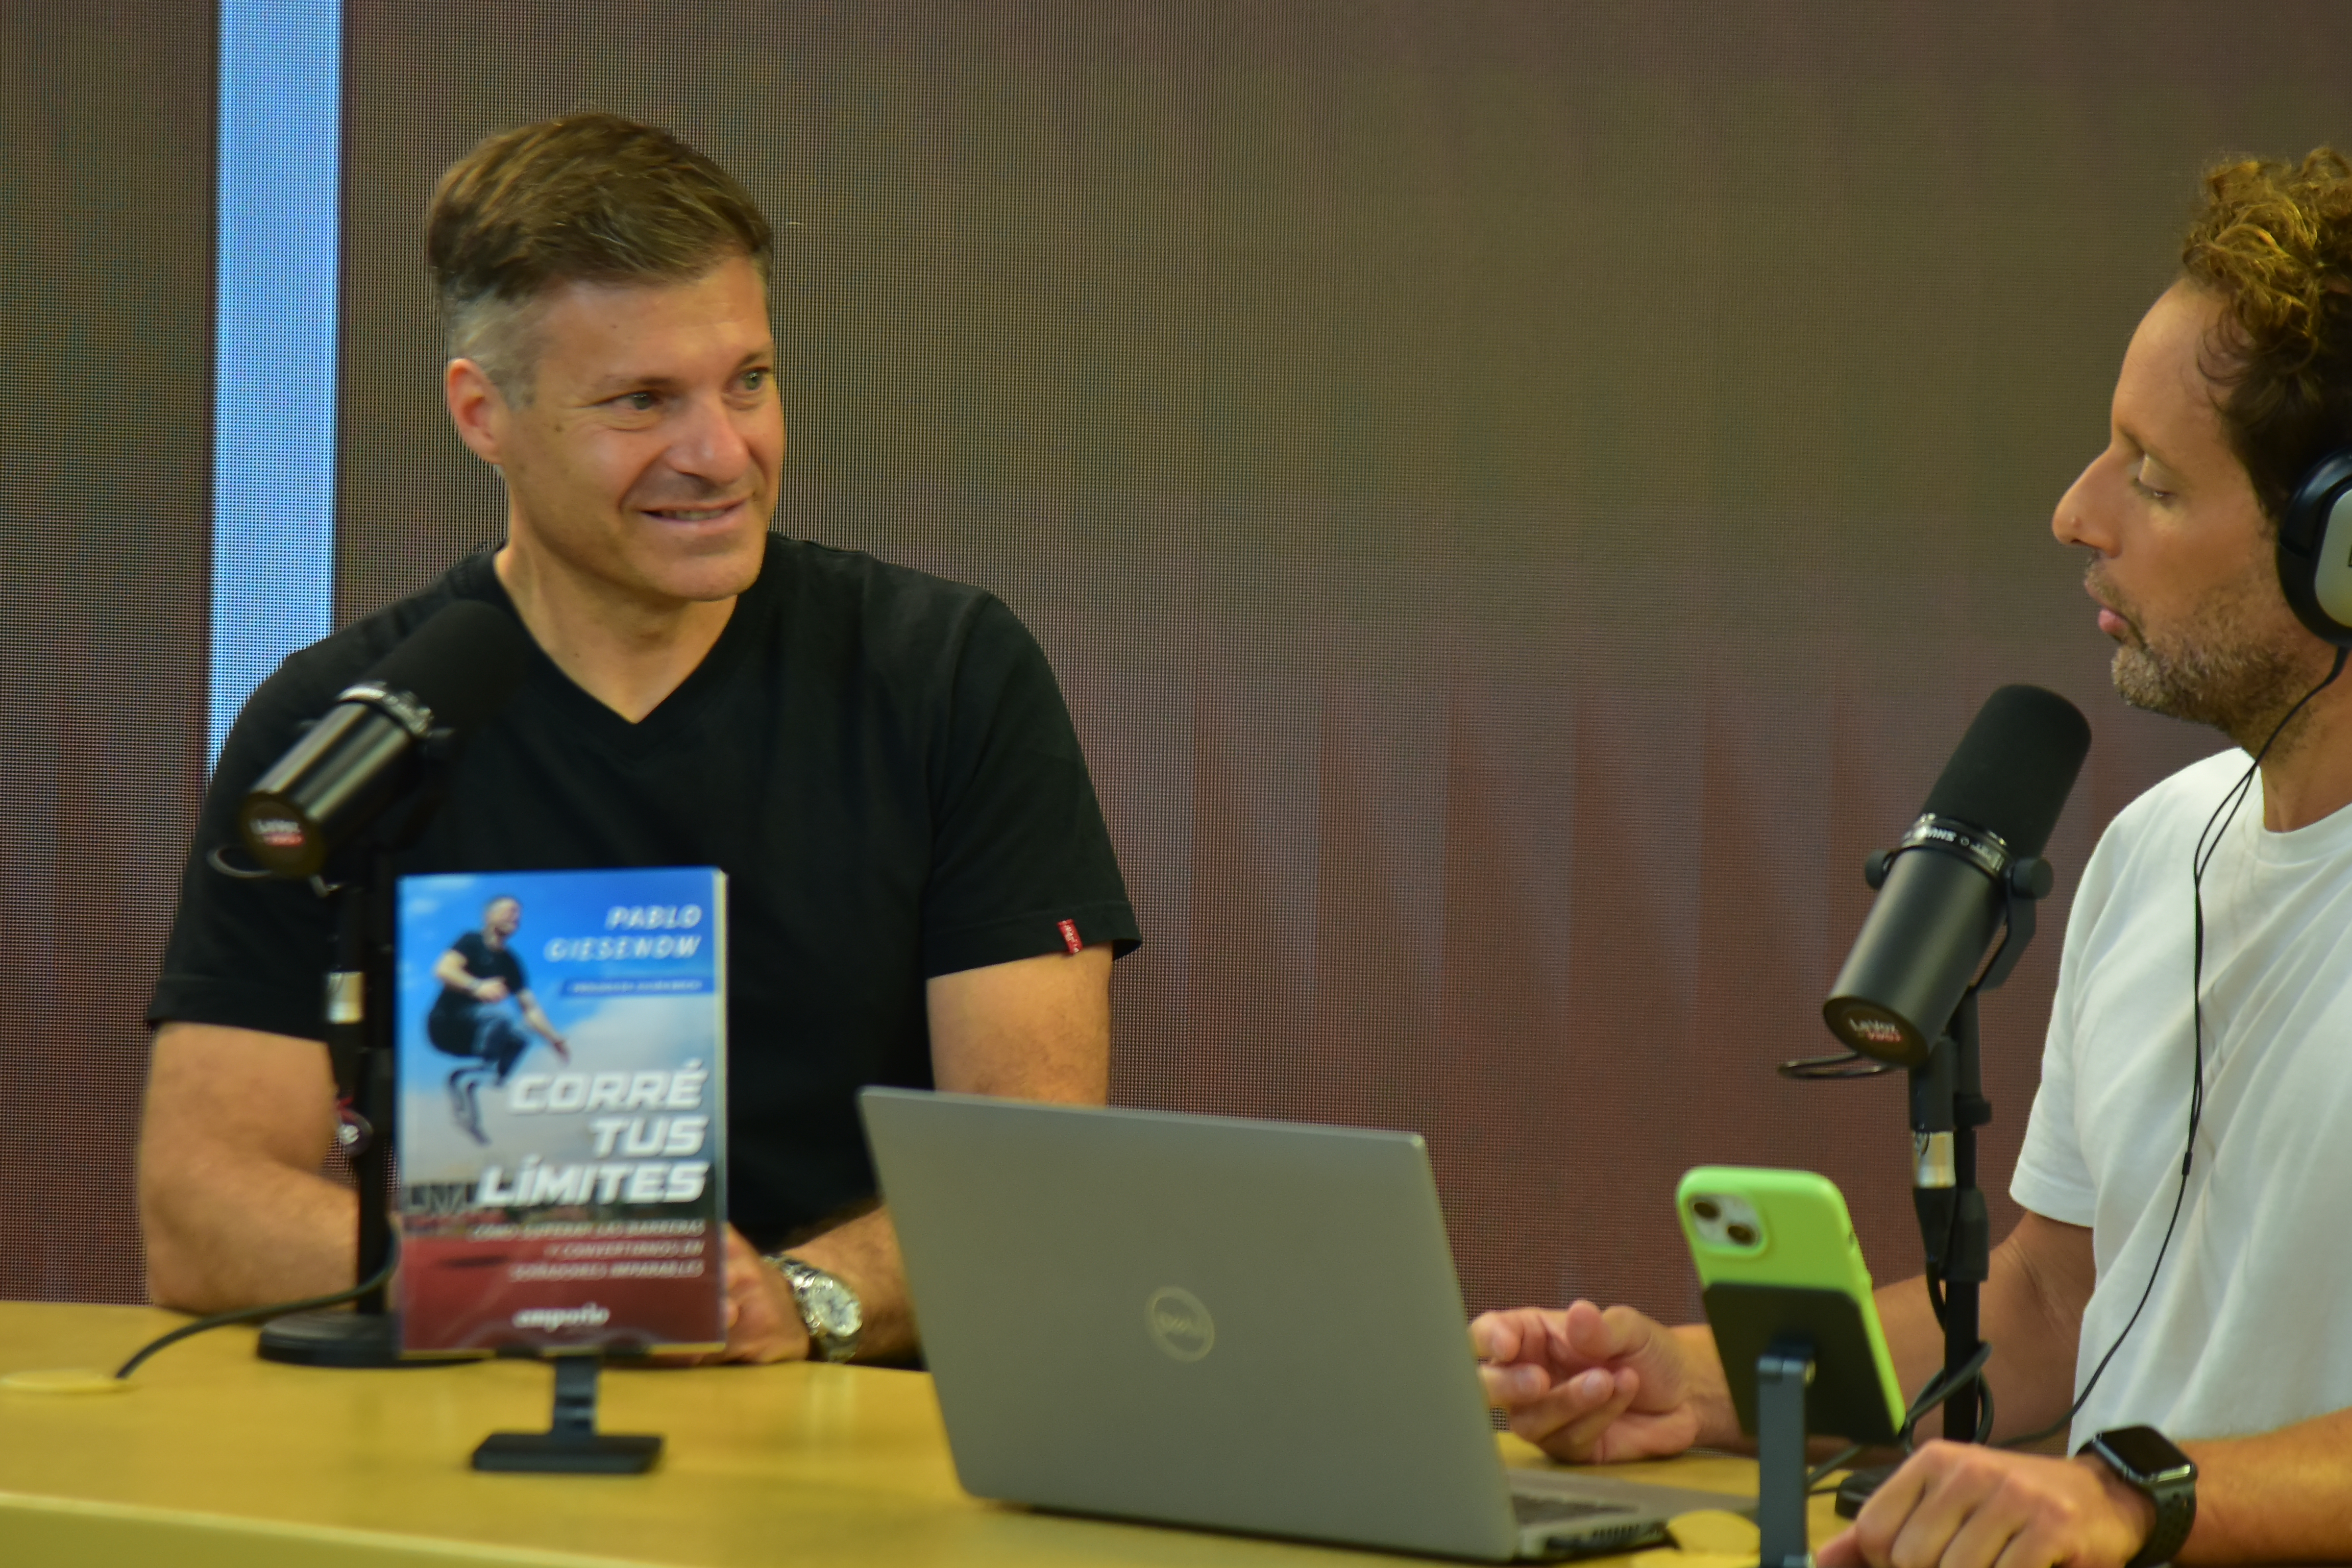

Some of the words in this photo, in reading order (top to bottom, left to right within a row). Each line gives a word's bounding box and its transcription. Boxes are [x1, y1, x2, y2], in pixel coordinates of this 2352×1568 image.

[606, 904, 702, 930] PABLO
[545, 935, 702, 961] GIESENOW
[511, 1059, 709, 1112] CORRÉ
[593, 1117, 709, 1157] TUS
[477, 1154, 710, 1206] LÍMITES
